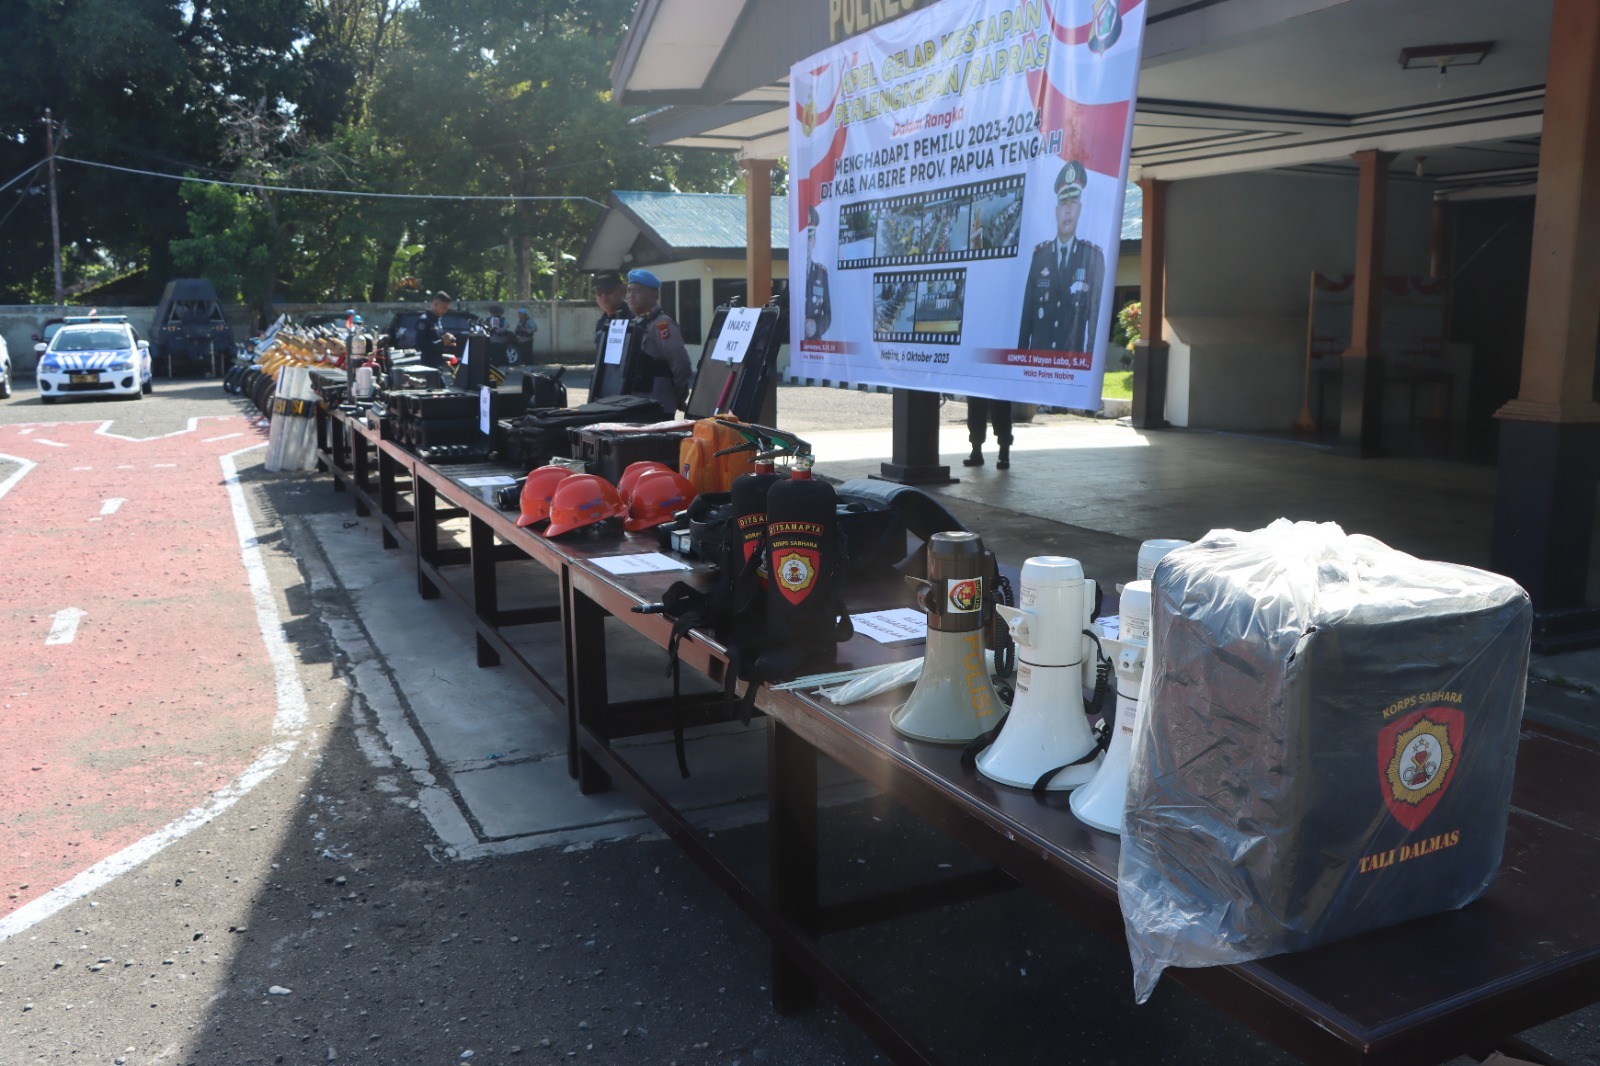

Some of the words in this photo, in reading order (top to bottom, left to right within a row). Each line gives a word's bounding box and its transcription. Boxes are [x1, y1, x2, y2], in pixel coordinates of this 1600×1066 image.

[841, 62, 877, 96] APEL
[882, 40, 936, 82] GELAR
[941, 1, 1043, 62] KESIAPAN
[892, 118, 922, 137] Dalam
[925, 107, 965, 129] Rangka
[834, 142, 909, 175] MENGHADAPI
[914, 129, 964, 158] PEMILU
[968, 108, 1041, 147] 2023-2024
[820, 180, 833, 200] DI
[859, 167, 906, 191] NABIRE
[910, 158, 946, 183] PROV.
[950, 149, 995, 176] PAPUA
[1000, 129, 1064, 165] TENGAH
[727, 319, 751, 332] INAFIS
[725, 340, 739, 351] KIT
[880, 349, 900, 363] Nabire,
[902, 350, 906, 361] 6
[906, 351, 932, 363] Oktober
[933, 352, 950, 364] 2023
[1033, 355, 1052, 365] Wayan
[1023, 370, 1037, 378] Waka
[1054, 371, 1075, 380] Nabire
[739, 515, 768, 526] DITSA
[769, 524, 820, 534] DITSAMAPTA
[964, 634, 993, 718] POLISI
[1382, 697, 1417, 719] KORPS
[1418, 691, 1463, 704] SABHARA
[1359, 851, 1397, 873] TALI
[1399, 830, 1460, 862] DALMAS
